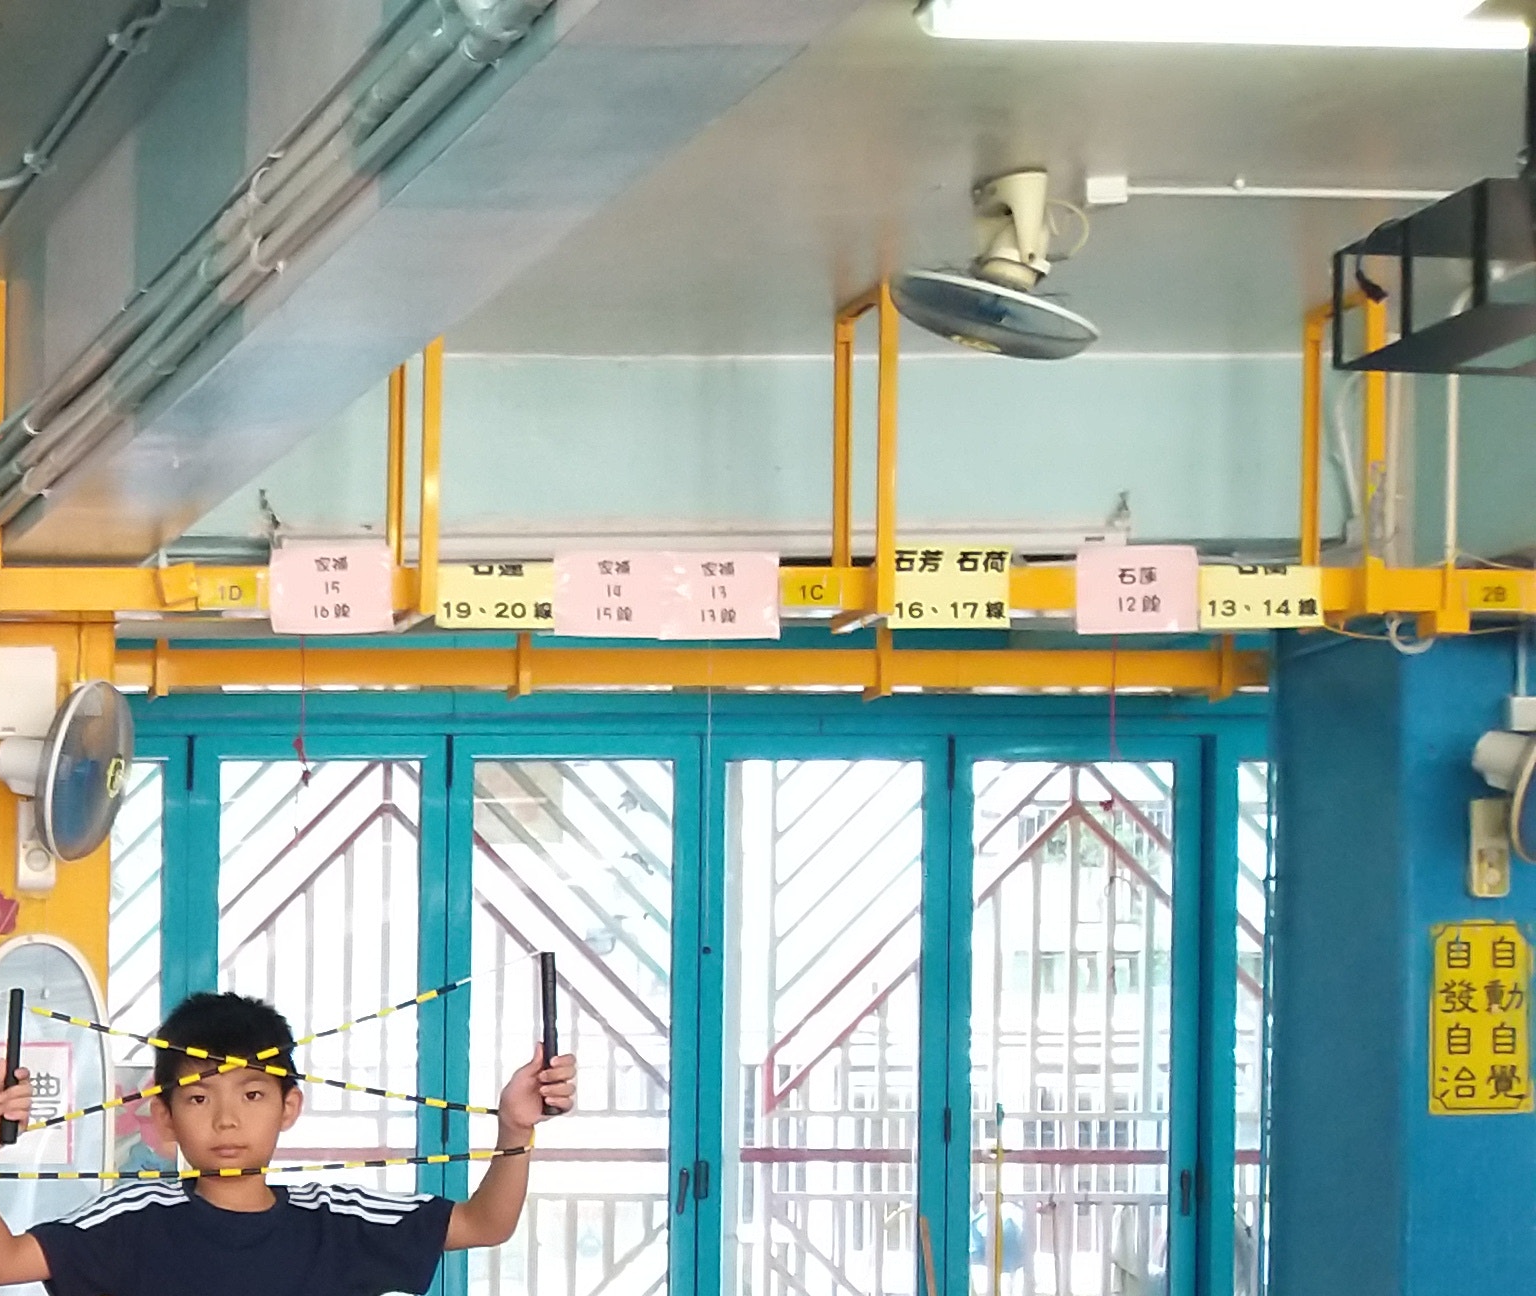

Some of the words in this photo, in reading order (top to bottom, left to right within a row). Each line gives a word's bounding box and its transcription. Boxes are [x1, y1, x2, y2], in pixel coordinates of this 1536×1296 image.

[895, 549, 944, 573] 石芳
[956, 551, 1009, 573] 石荷
[218, 585, 243, 601] 1D
[324, 580, 341, 595] 15
[711, 585, 727, 600] 13
[799, 584, 824, 601] 1C
[1481, 585, 1507, 603] 2B
[1439, 936, 1478, 1099] 自發自治
[1484, 936, 1527, 1100] 自動自覺
